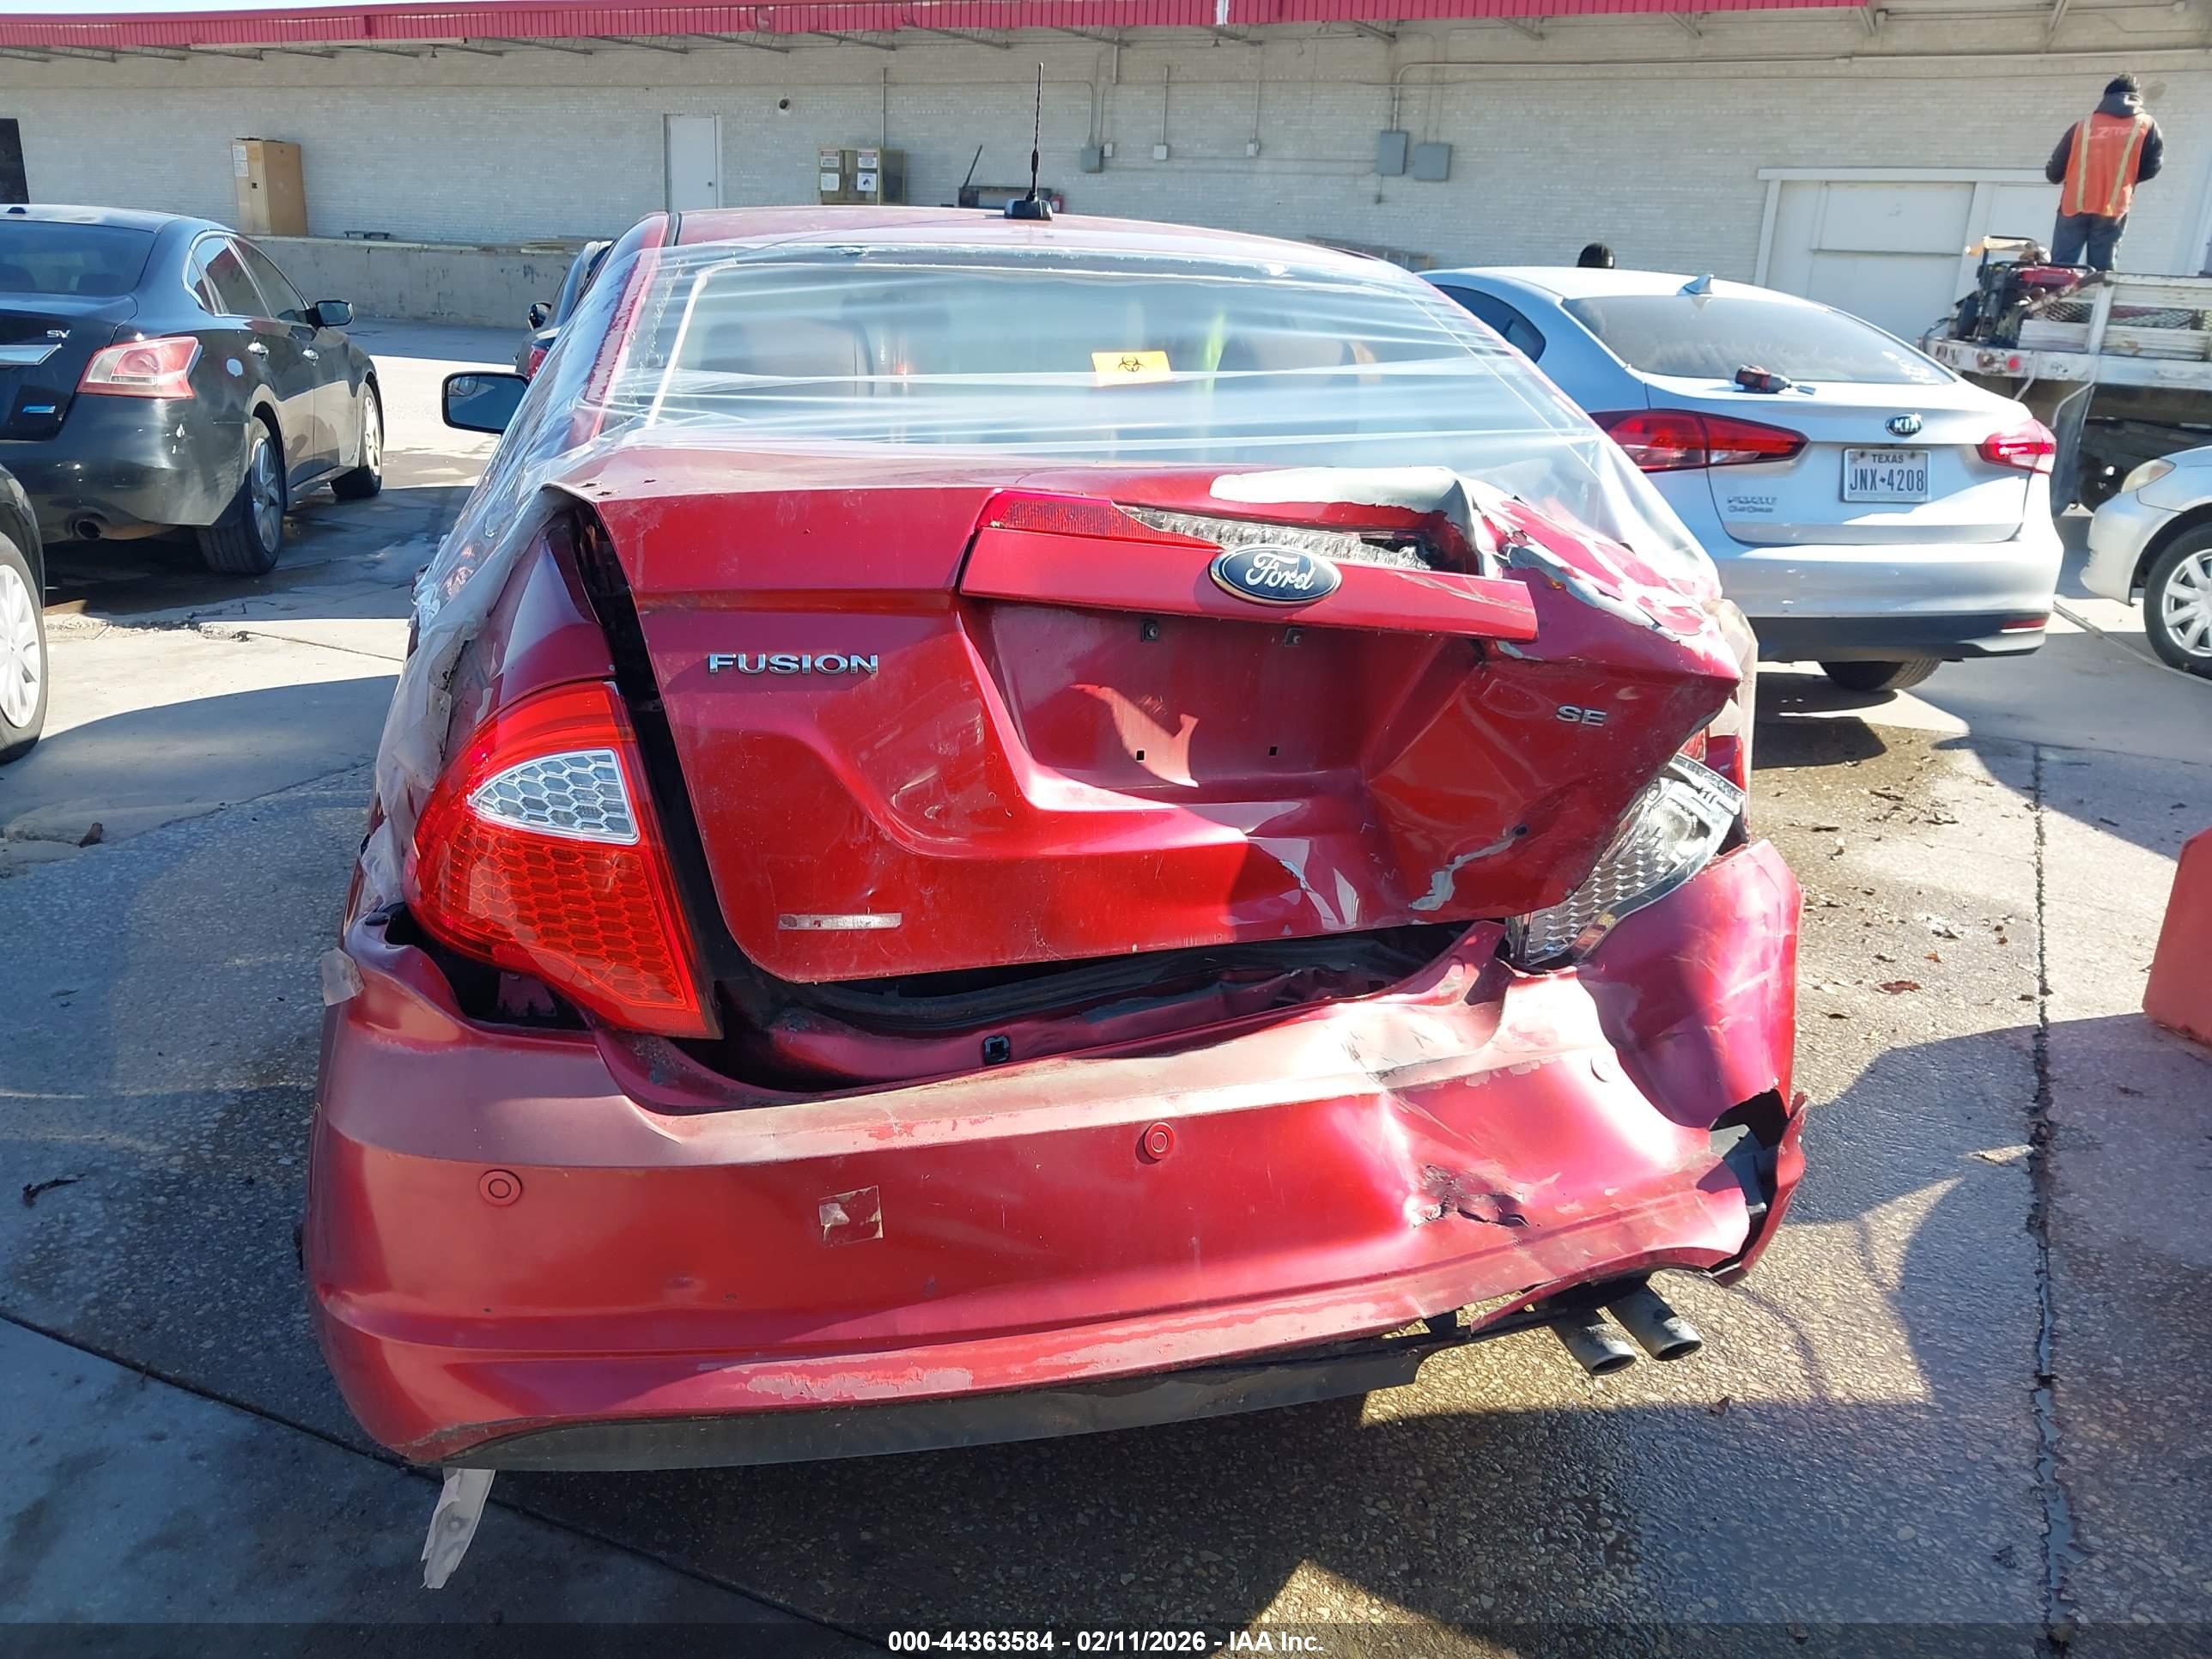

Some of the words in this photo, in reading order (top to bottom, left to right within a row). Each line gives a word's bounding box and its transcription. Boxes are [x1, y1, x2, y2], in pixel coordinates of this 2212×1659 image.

[46, 329, 71, 338] SV
[1893, 417, 1920, 433] KIA
[1872, 453, 1905, 465] TEXAS
[1245, 551, 1316, 591] Ford
[708, 653, 879, 675] FUSION
[1555, 704, 1608, 728] SE
